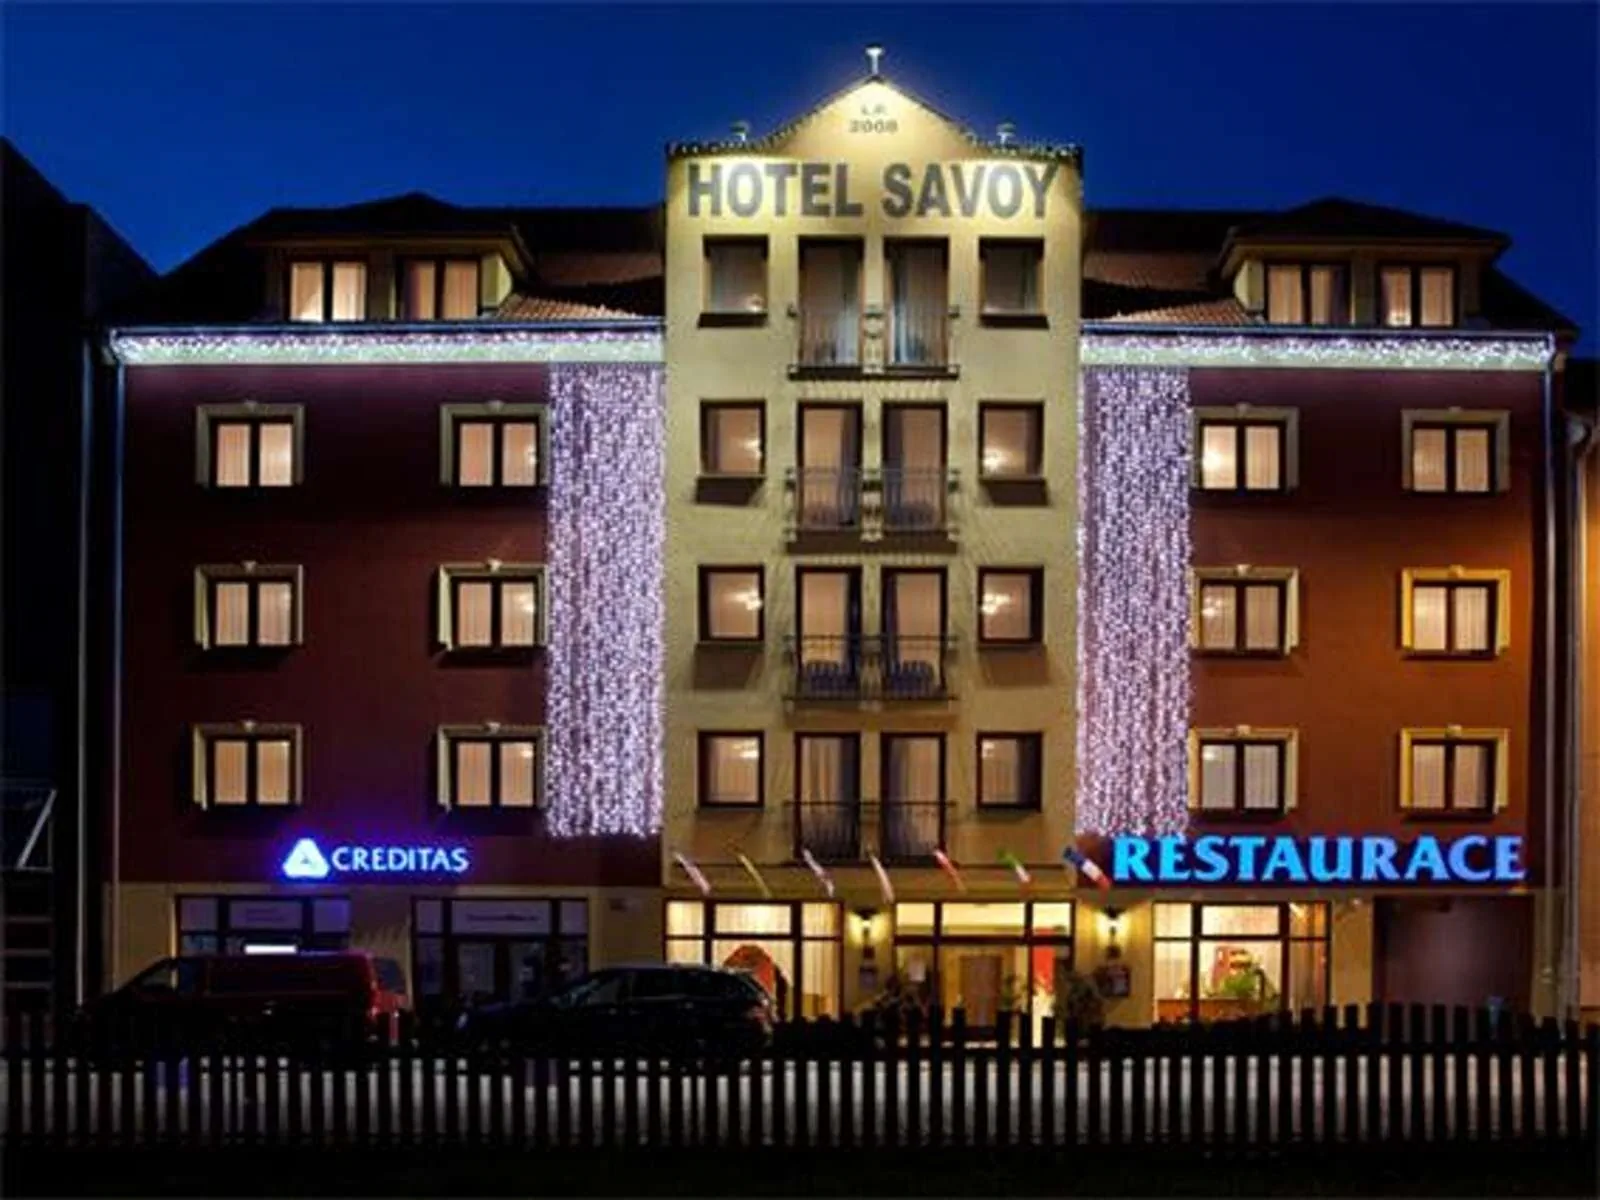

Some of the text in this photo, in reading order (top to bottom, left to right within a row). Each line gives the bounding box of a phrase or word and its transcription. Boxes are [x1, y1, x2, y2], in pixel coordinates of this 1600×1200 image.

[687, 162, 1059, 218] HOTEL SAVOY
[331, 846, 470, 872] CREDITAS
[1112, 834, 1527, 882] RESTAURACE
